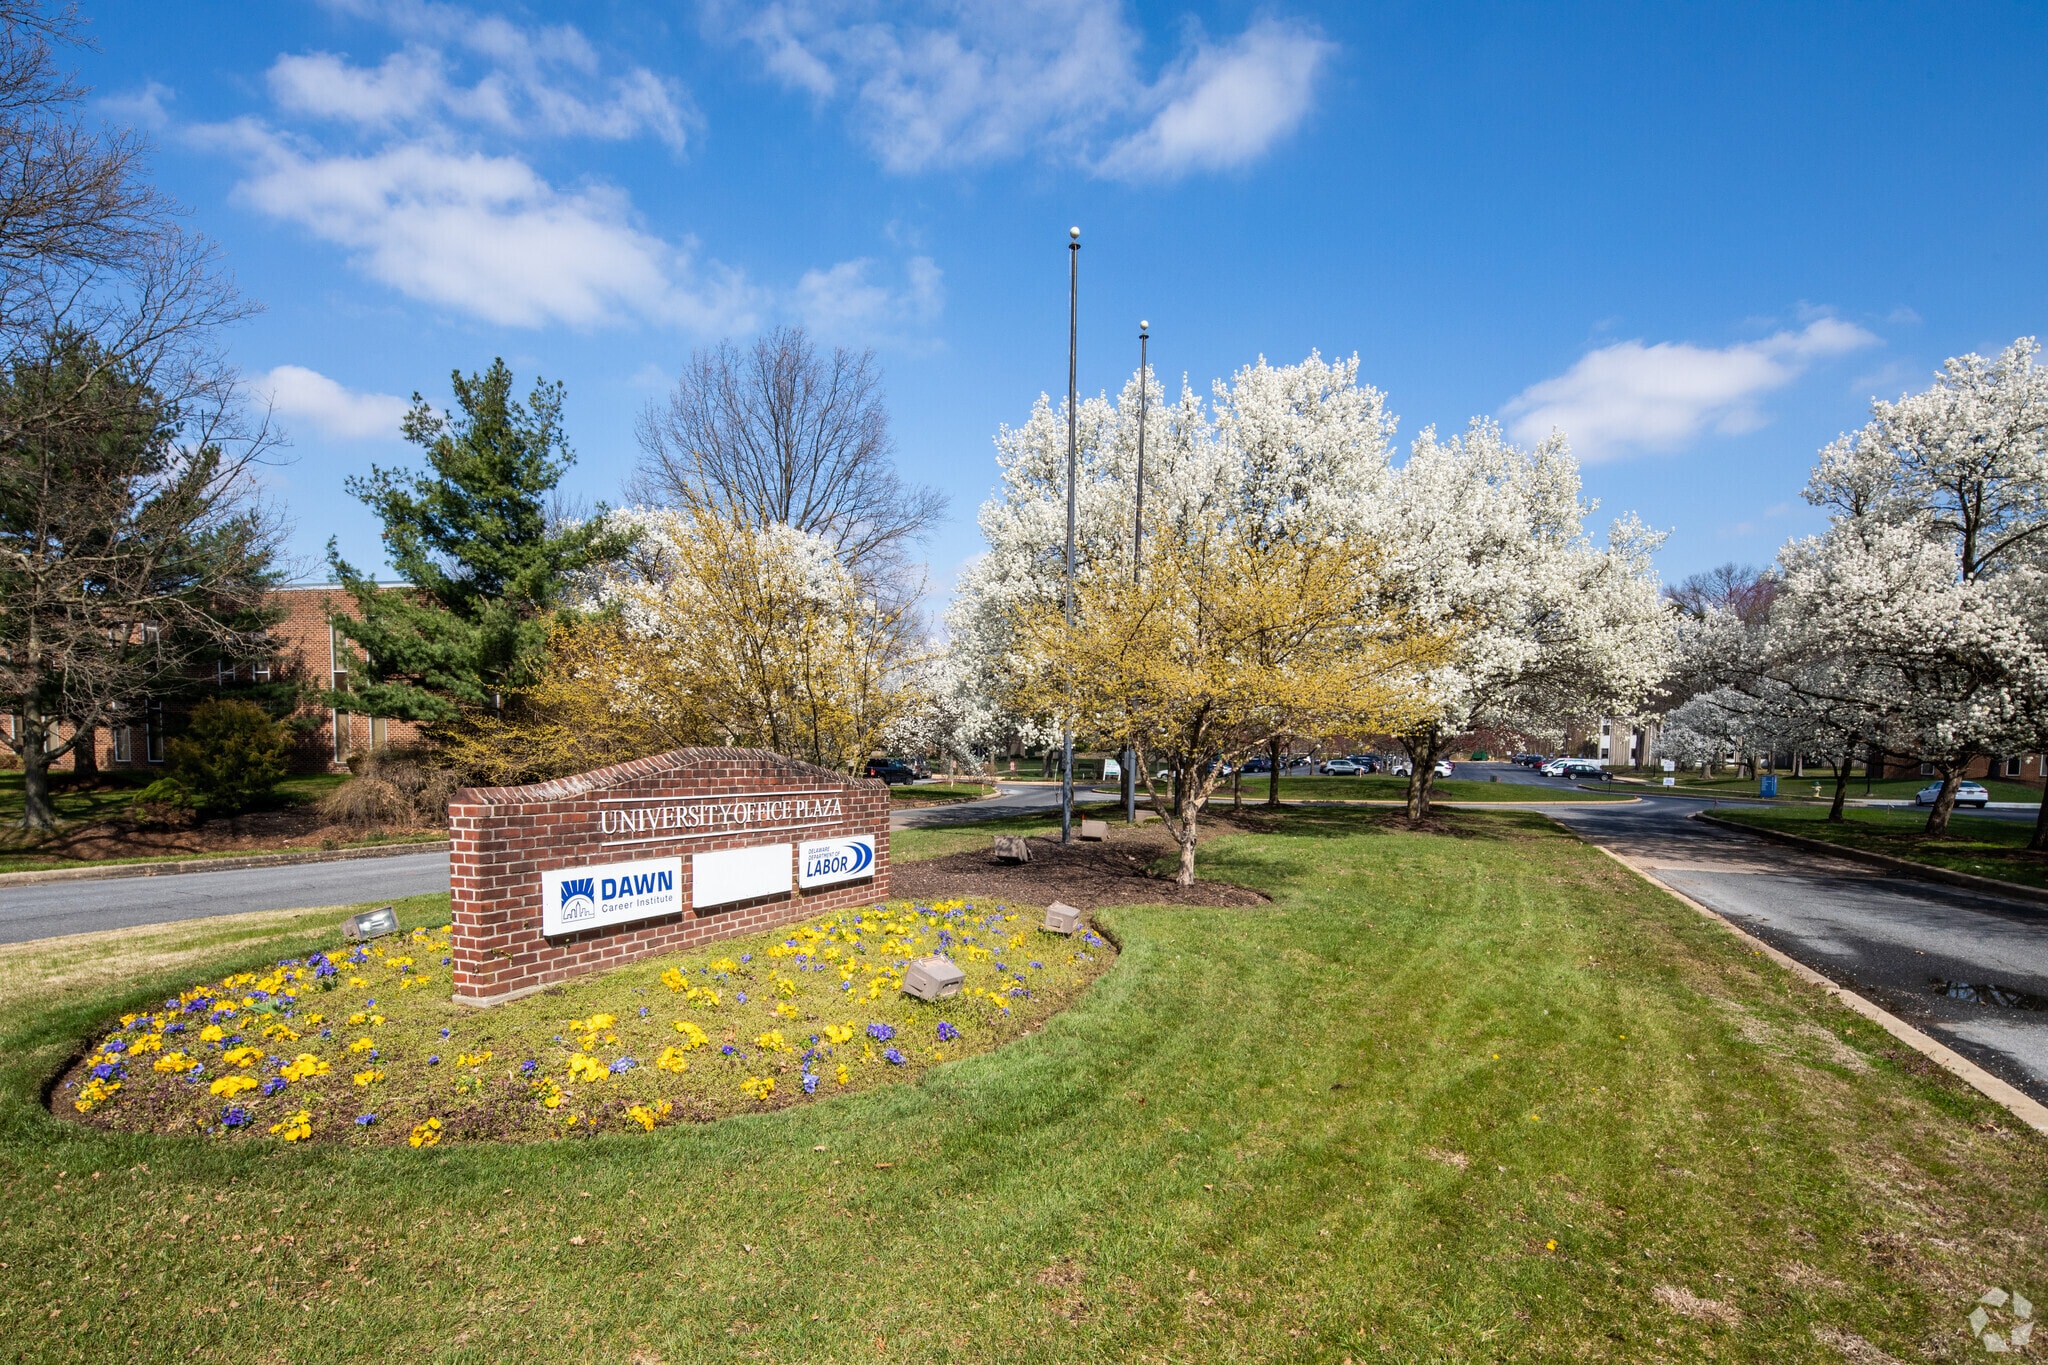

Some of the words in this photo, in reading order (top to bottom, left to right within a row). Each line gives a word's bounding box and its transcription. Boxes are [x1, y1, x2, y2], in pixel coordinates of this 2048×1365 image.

[601, 804, 731, 834] UNIVERSITY
[733, 800, 792, 824] OFFICE
[796, 798, 842, 818] PLAZA
[808, 846, 830, 855] DELAWARE
[807, 856, 848, 877] LABOR
[601, 870, 673, 901] DAWN
[601, 901, 633, 913] Career
[636, 895, 673, 907] Institute
